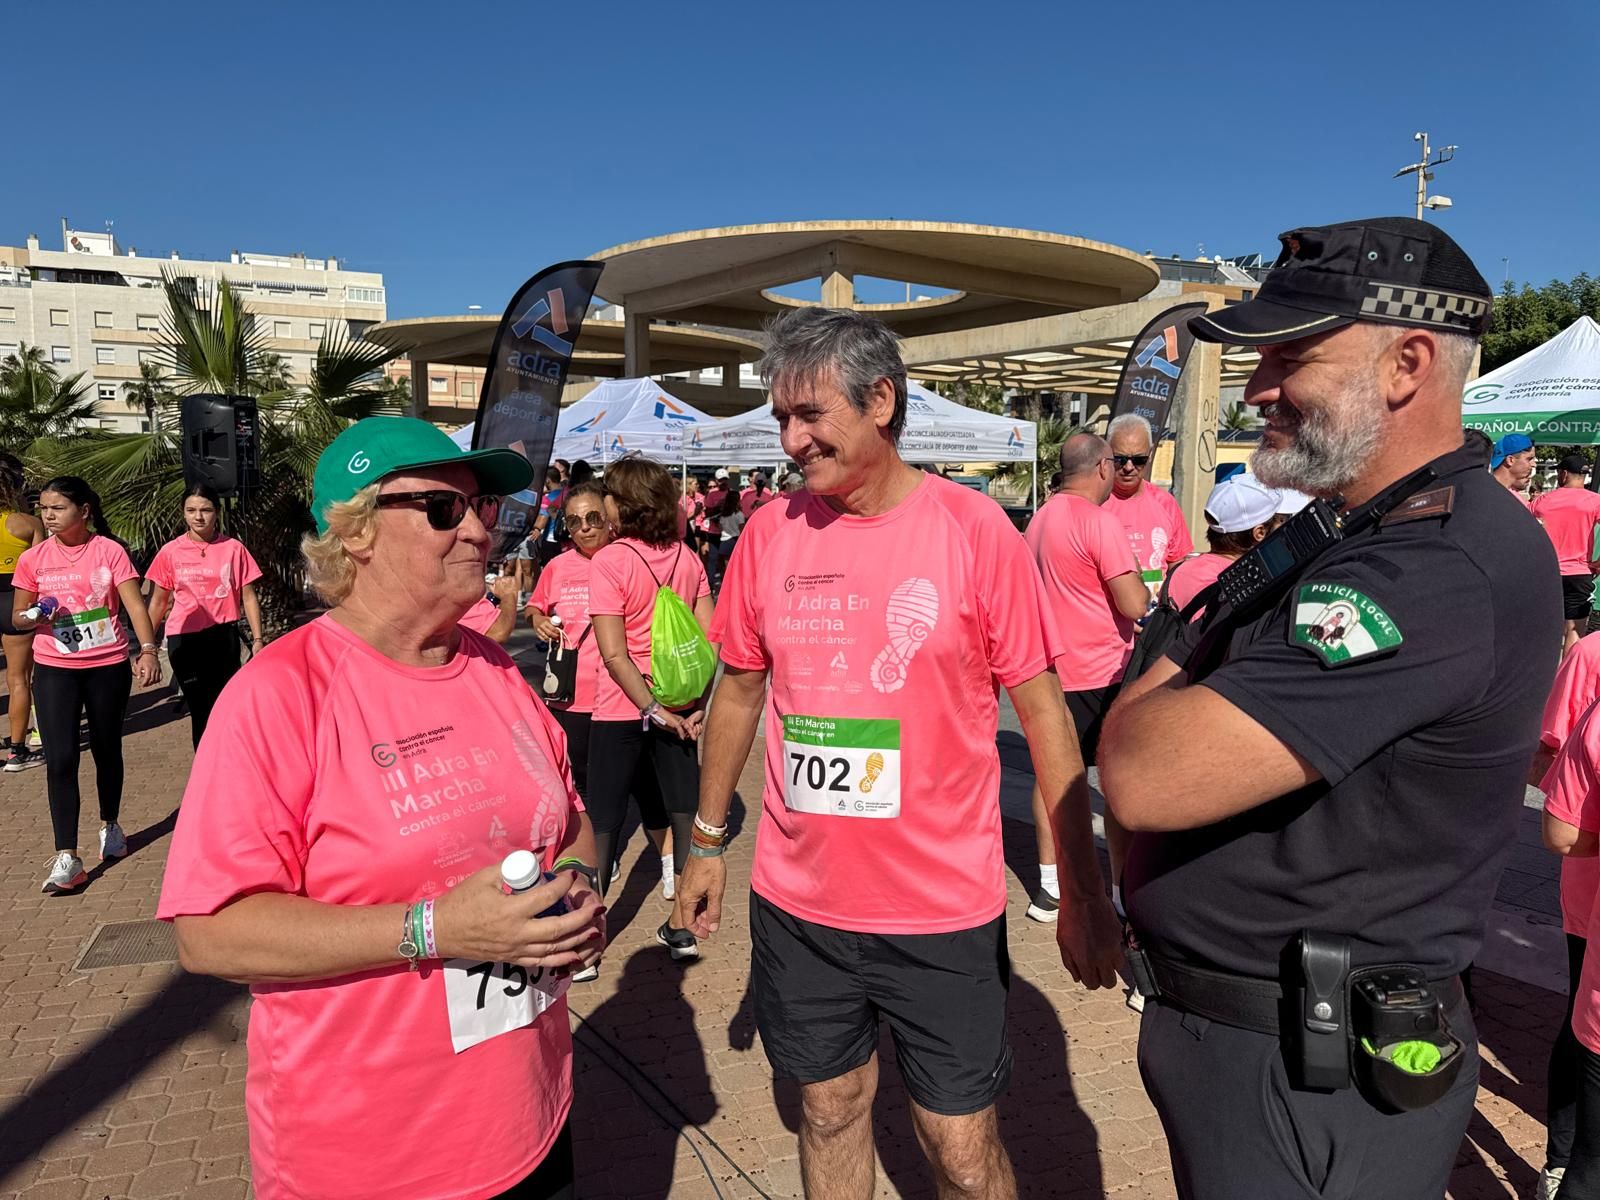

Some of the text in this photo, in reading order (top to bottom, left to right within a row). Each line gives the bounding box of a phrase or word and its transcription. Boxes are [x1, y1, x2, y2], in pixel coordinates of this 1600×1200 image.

[507, 351, 561, 379] adra
[506, 366, 559, 386] AYUNTAMIENTO
[1131, 375, 1170, 396] adra
[1514, 377, 1579, 388] asociación
[511, 387, 542, 406] área
[1129, 389, 1167, 402] AYUNTAMIENTO
[1509, 385, 1549, 394] contra
[1519, 391, 1571, 399] Almería
[494, 400, 552, 426] deportes
[1537, 421, 1600, 433] CONTRA
[798, 594, 841, 610] Adra
[848, 594, 869, 611] En
[1311, 584, 1393, 635] POLICÍA LOCAL
[777, 615, 845, 631] Marcha
[61, 626, 93, 645] 361
[775, 635, 806, 645] contra
[809, 635, 819, 645] el
[795, 717, 804, 726] En
[805, 719, 836, 730] Marcha
[380, 746, 499, 793] III Adra En
[790, 752, 851, 792] 702
[390, 776, 487, 820] Marcha
[399, 793, 508, 837] contra el cáncer
